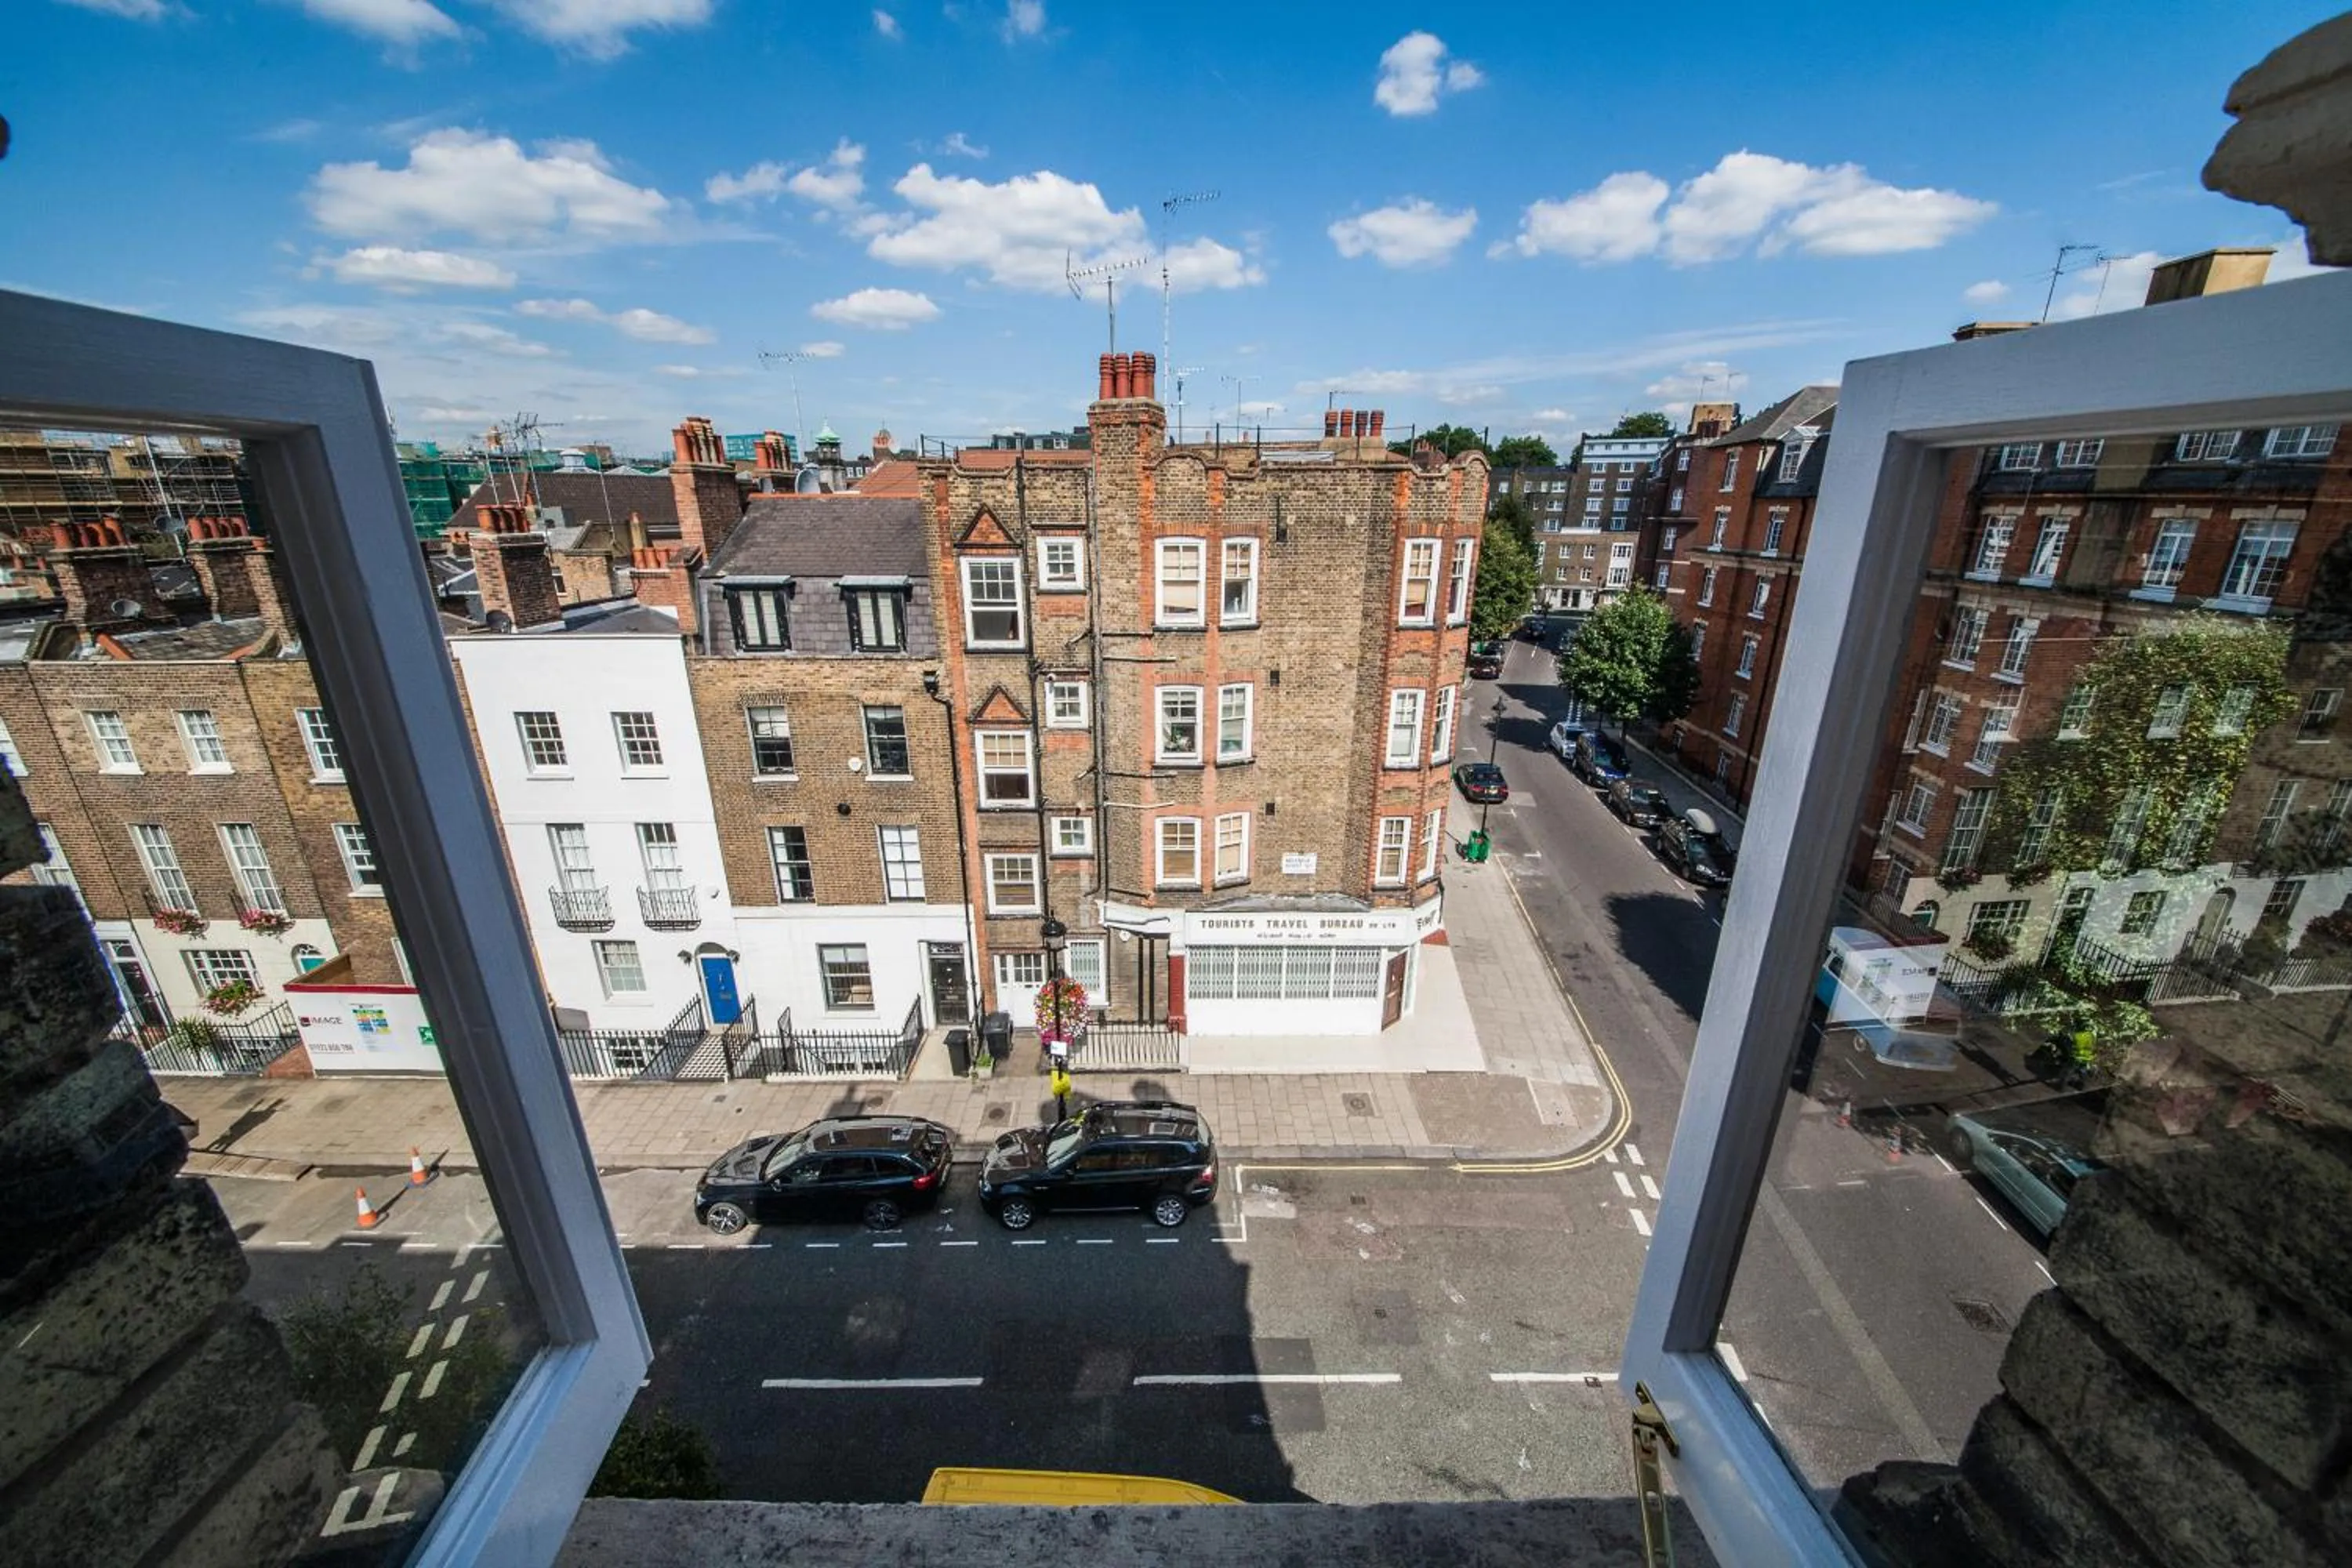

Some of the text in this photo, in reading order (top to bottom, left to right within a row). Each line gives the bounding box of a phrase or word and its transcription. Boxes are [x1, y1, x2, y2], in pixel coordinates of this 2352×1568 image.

[1200, 919, 1255, 929] TOURISTS
[1266, 919, 1308, 929] TRAVEL
[1319, 919, 1364, 929] BUREAU
[310, 1015, 343, 1025] IMAGE
